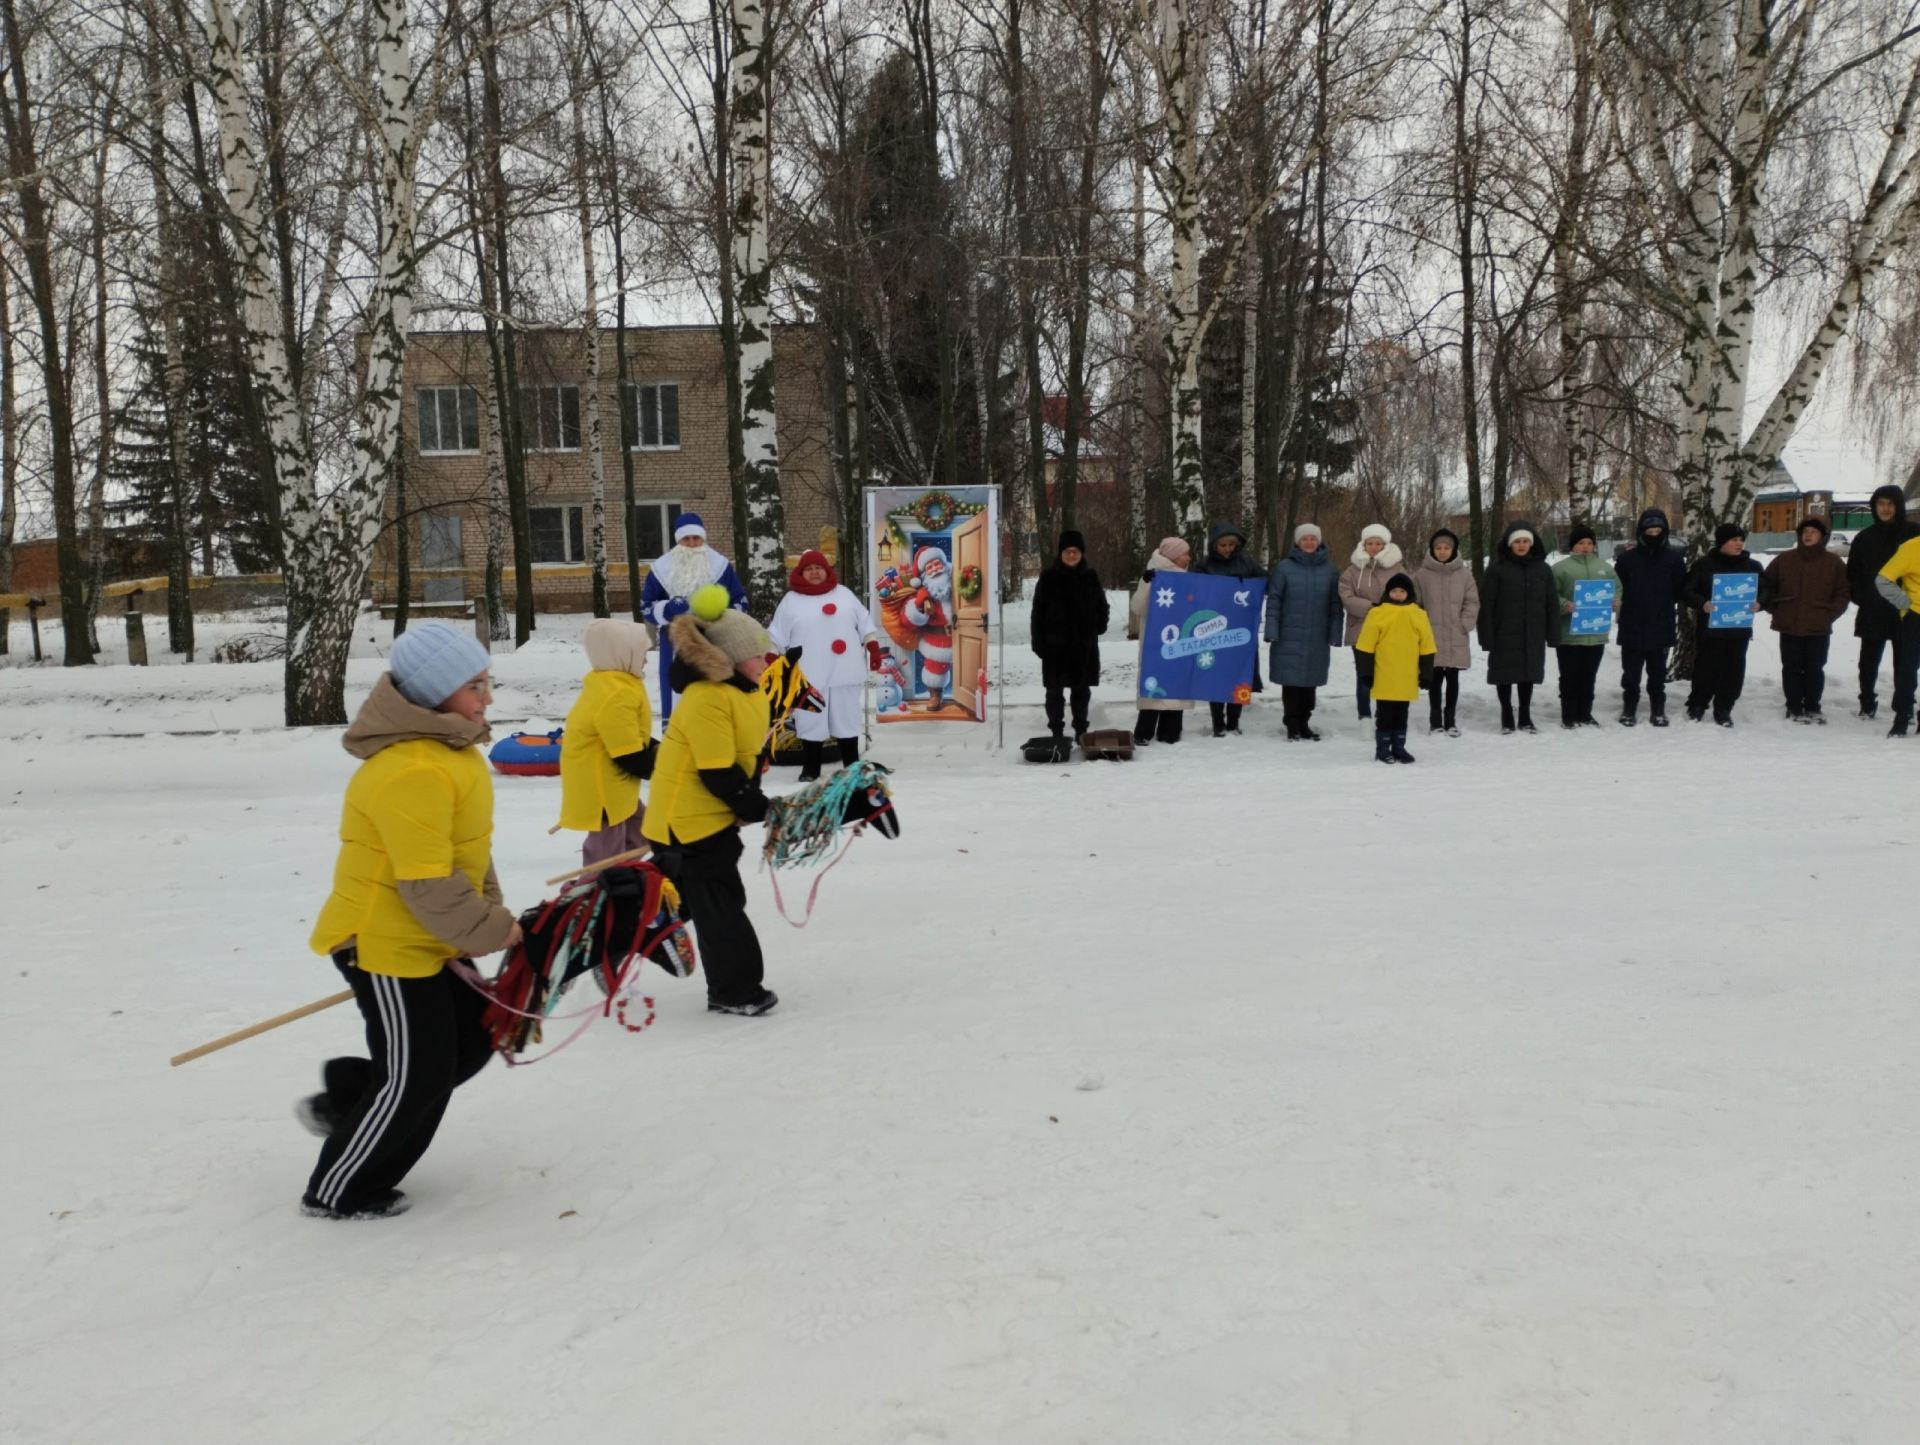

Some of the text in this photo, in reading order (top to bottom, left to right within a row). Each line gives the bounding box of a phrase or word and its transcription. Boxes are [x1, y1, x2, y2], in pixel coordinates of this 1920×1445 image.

[1197, 620, 1224, 636] ЗИМА
[1168, 632, 1242, 656] В ТАТАРСТАНЕ
